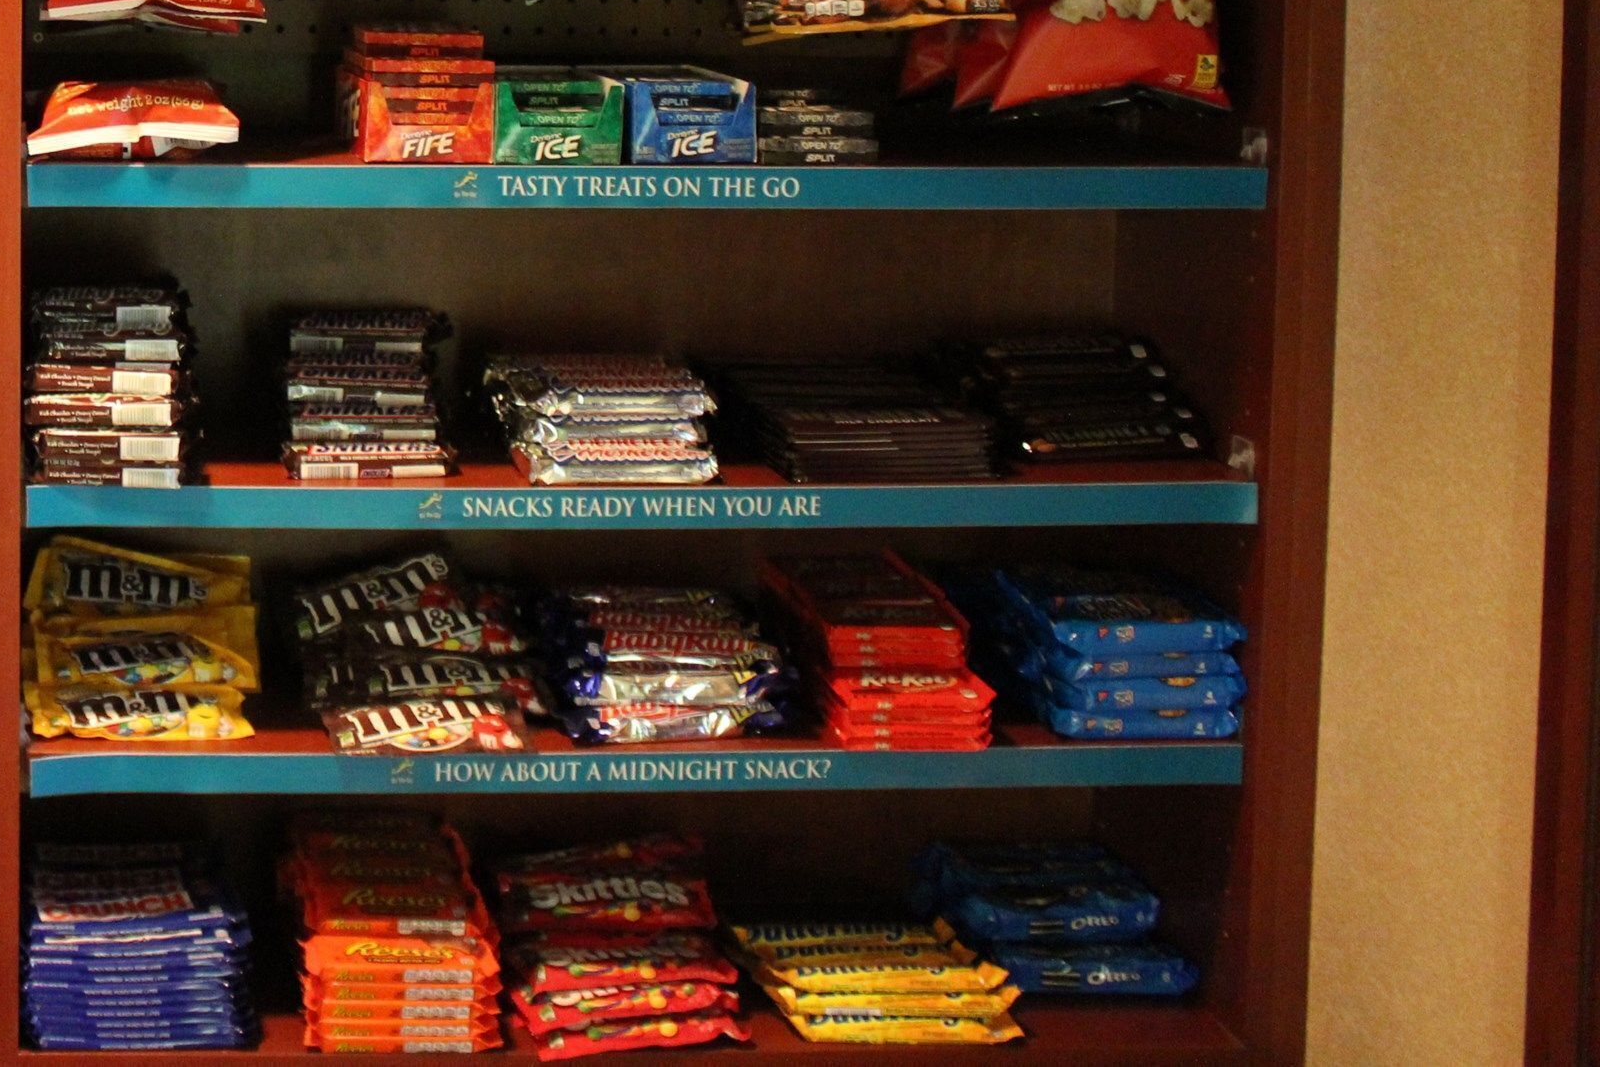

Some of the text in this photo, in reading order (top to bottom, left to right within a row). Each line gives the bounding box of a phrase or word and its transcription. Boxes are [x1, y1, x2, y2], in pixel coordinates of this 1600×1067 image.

[419, 74, 450, 84] SPLIT
[655, 84, 680, 93] OPEN
[96, 95, 143, 113] weight
[416, 101, 447, 111] SPLIT
[660, 98, 689, 107] SPLIT
[538, 115, 562, 124] OPEN
[802, 126, 832, 136] SPLIT
[403, 131, 456, 159] FIRE
[535, 135, 582, 161] ICE
[672, 130, 717, 158] ICE
[802, 141, 826, 150] OPEN
[805, 153, 836, 163] SPLIT
[498, 174, 800, 199] TASTY TREATS ON THE GO
[463, 496, 821, 518] SNACKS READY WHEN YOU ARE
[435, 758, 832, 782] HOW ABOUT A MIDNIGHT SNACK?
[529, 877, 689, 910] Skittles
[1070, 916, 1119, 931] OREO
[1087, 971, 1141, 987] OREO
